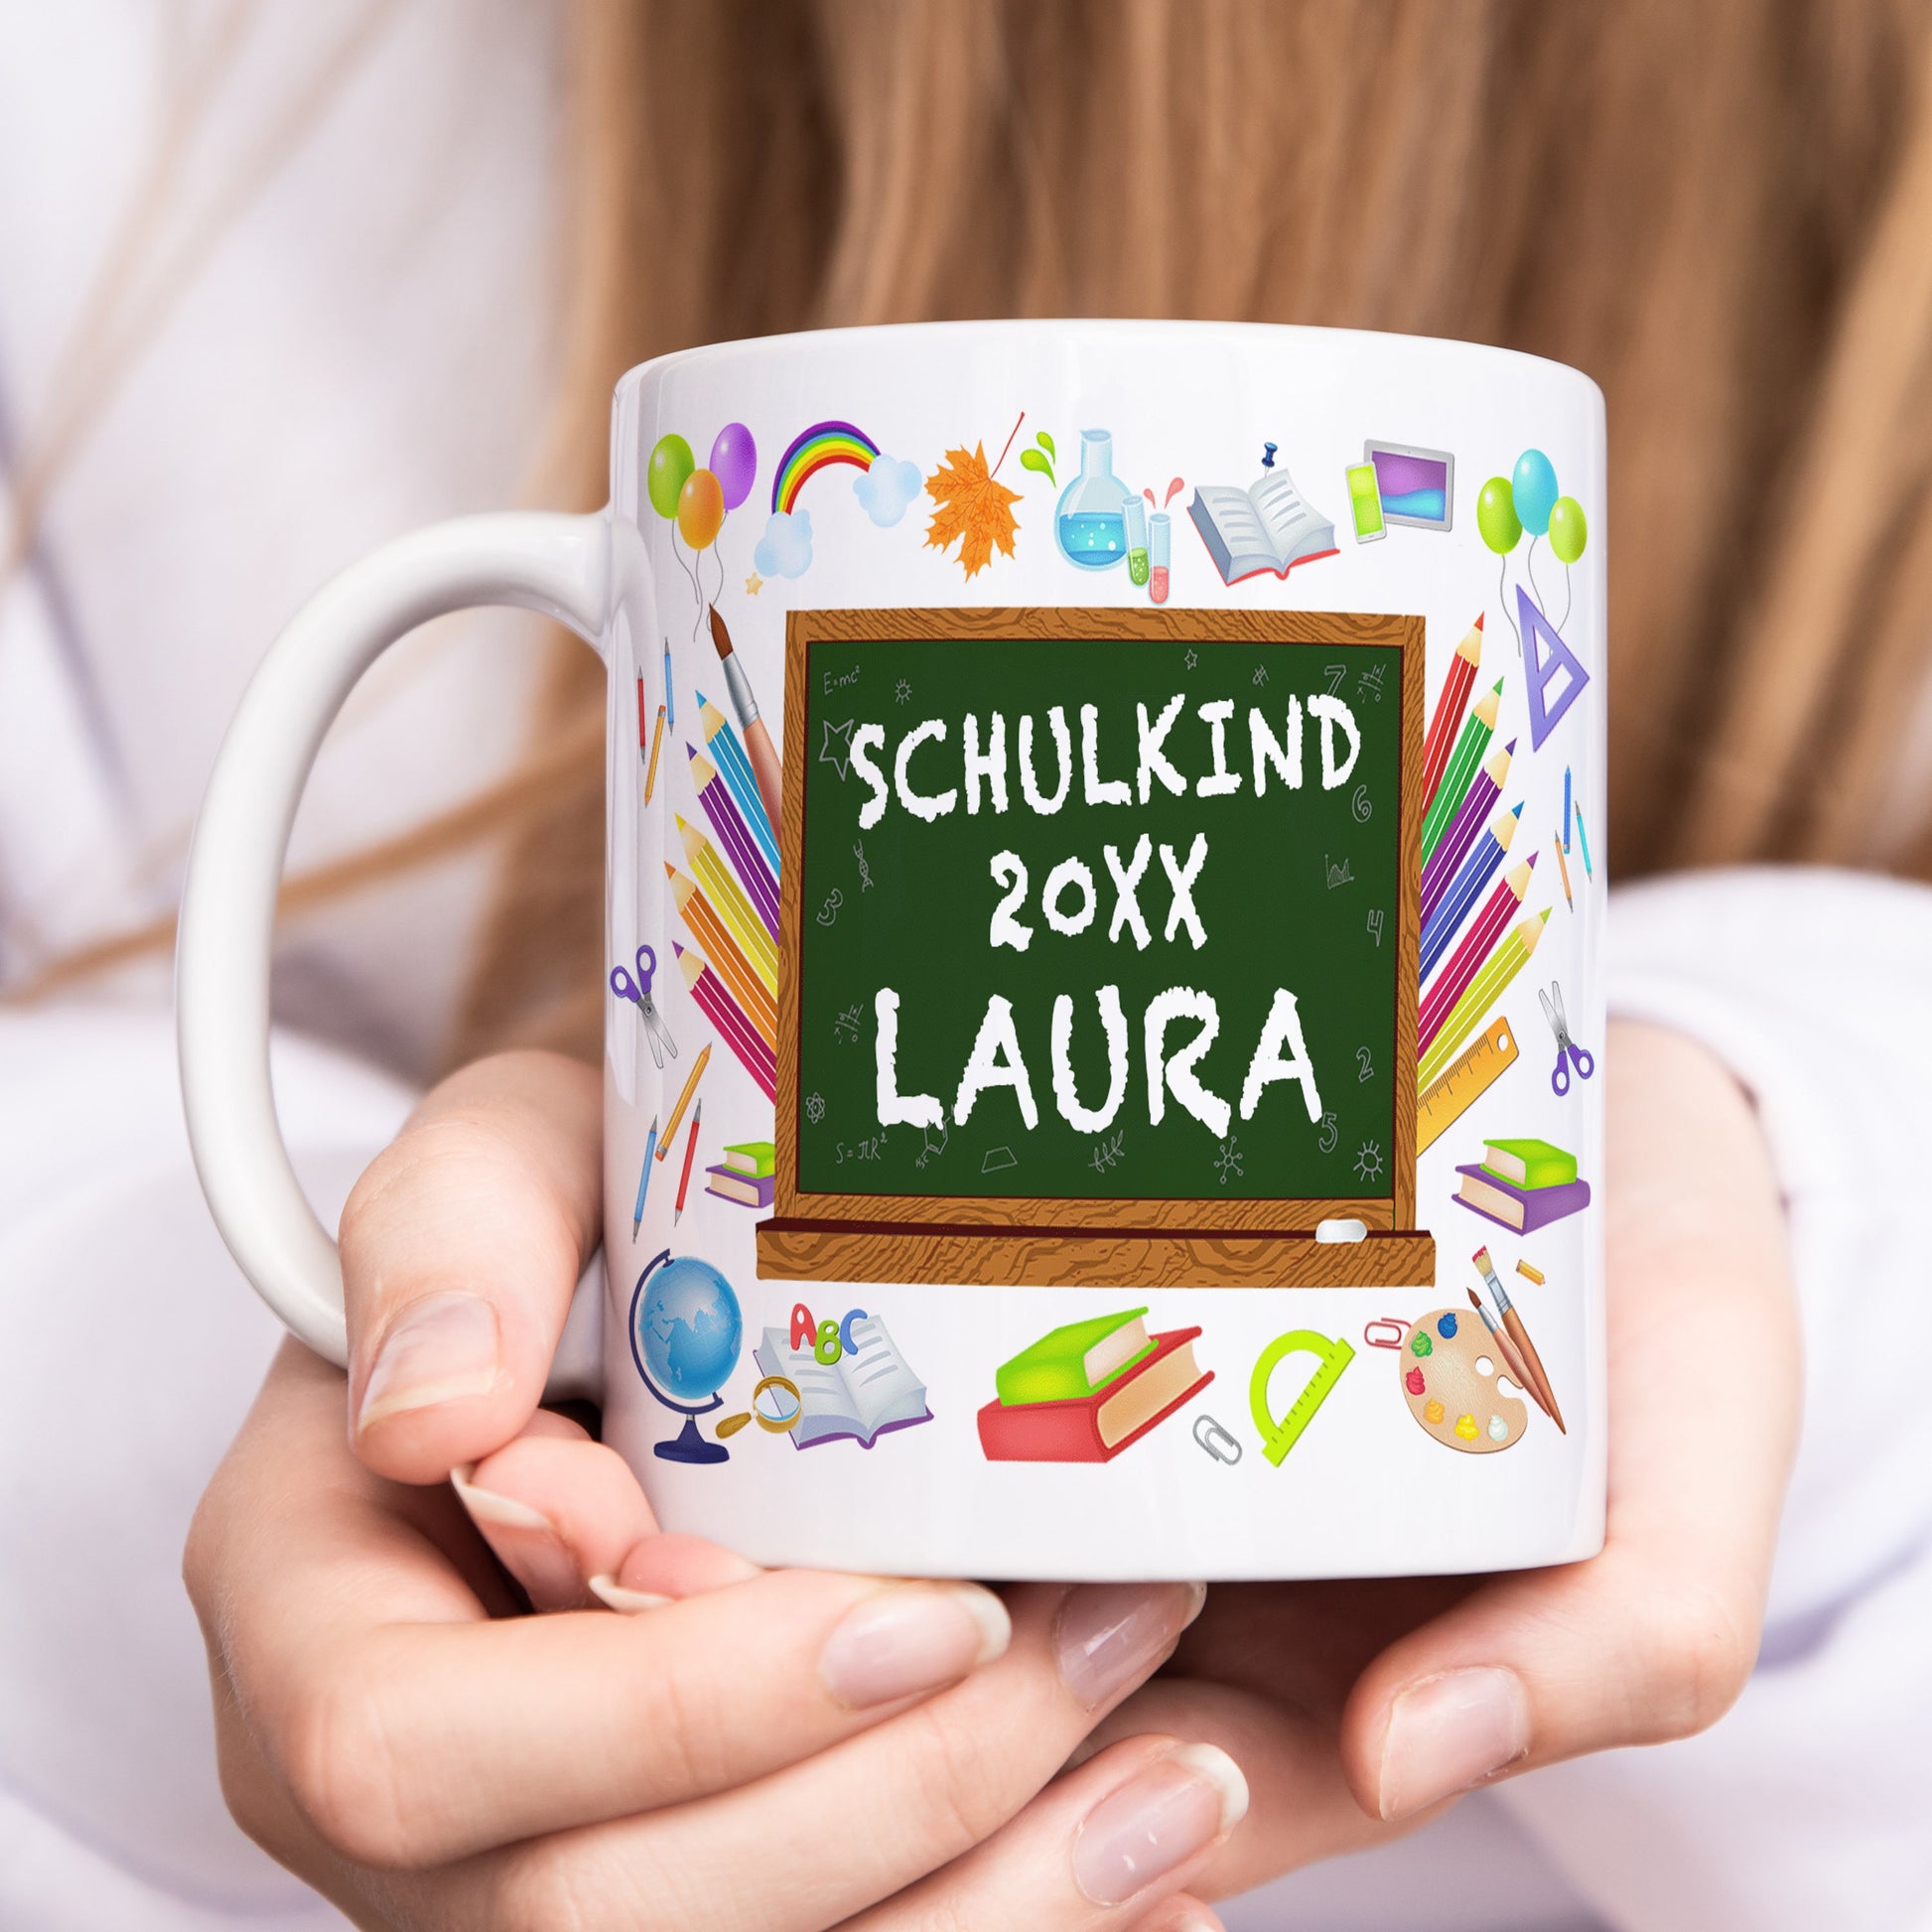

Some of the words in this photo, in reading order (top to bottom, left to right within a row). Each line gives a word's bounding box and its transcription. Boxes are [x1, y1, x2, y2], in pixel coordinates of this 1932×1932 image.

[850, 694, 1360, 829] SCHULKIND
[1351, 784, 1373, 823] 6
[816, 889, 844, 926] 3
[990, 833, 1207, 951] 20XX
[1366, 909, 1384, 947] 4
[876, 985, 1322, 1139] LAURA
[1355, 1045, 1375, 1083] 2
[1318, 1111, 1338, 1154] 5
[790, 1303, 869, 1366] ABC
